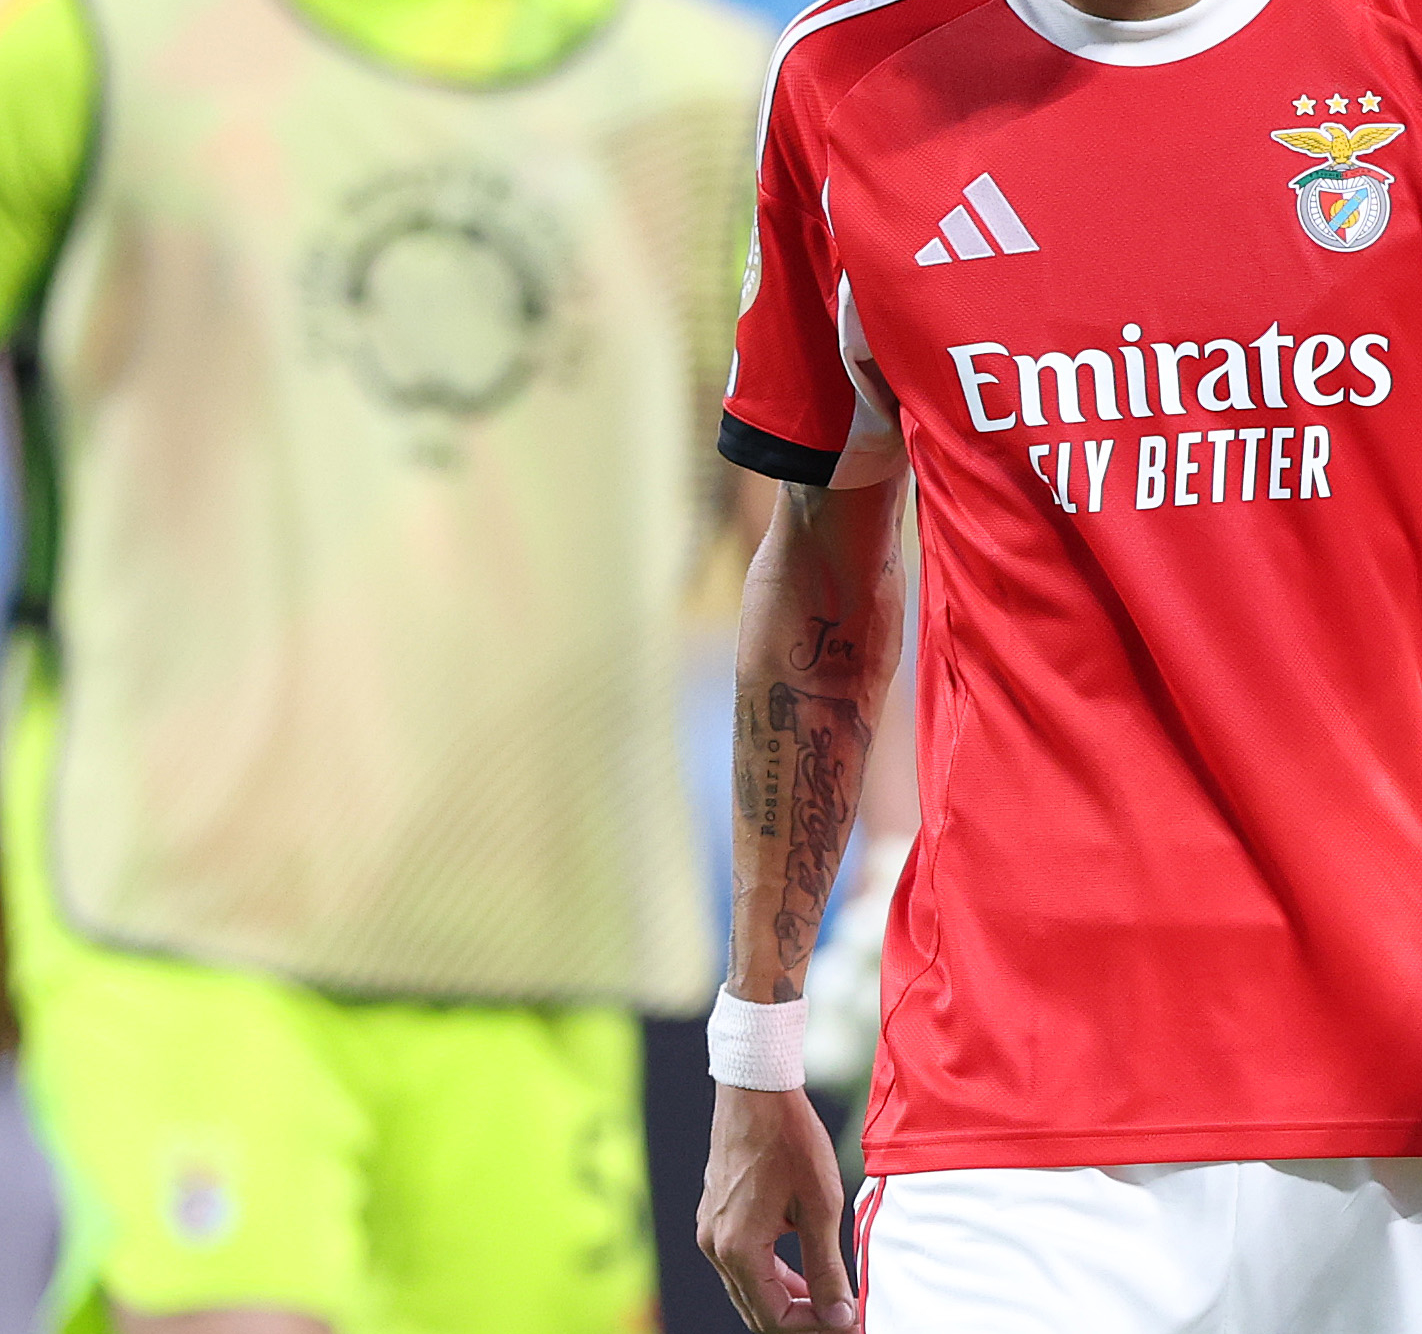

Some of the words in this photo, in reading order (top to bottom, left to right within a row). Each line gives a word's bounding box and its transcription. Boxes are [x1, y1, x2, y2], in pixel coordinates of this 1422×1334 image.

[947, 320, 1393, 433] Emirates
[1028, 439, 1115, 514] FLY
[1135, 424, 1332, 510] BETTER
